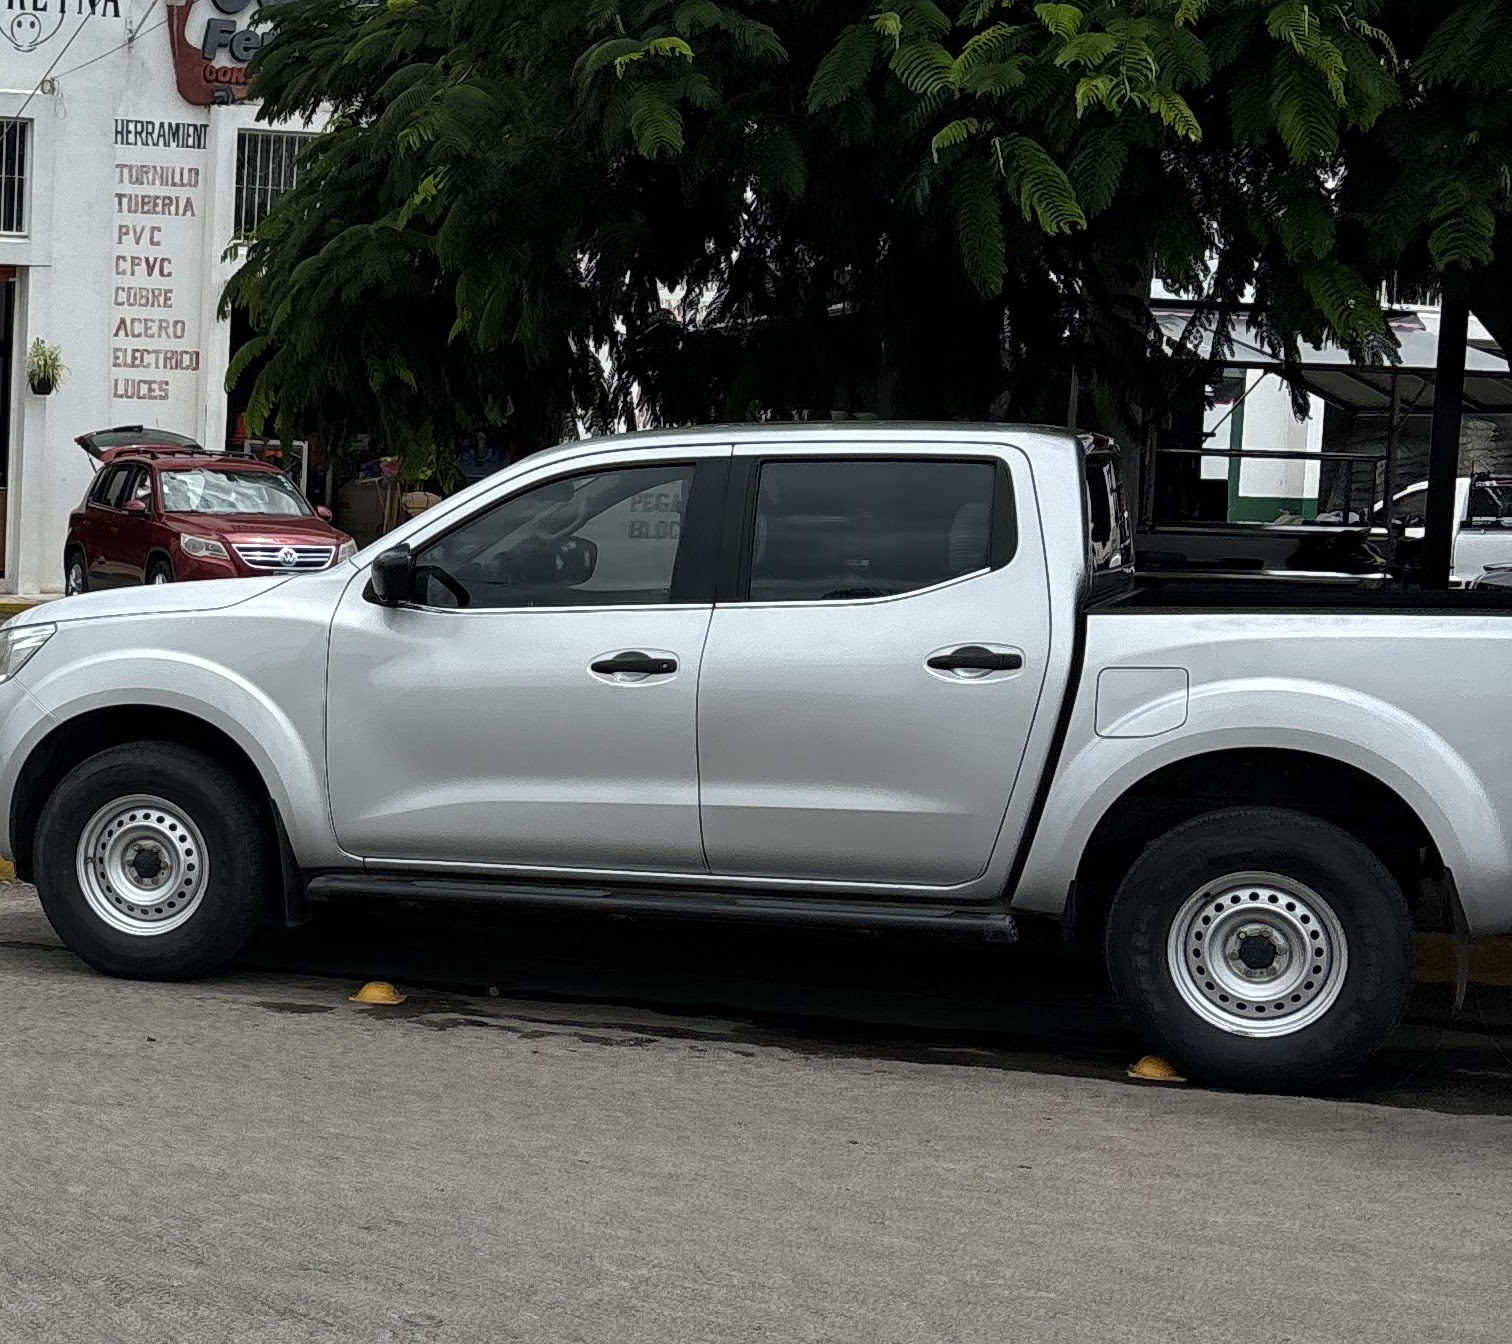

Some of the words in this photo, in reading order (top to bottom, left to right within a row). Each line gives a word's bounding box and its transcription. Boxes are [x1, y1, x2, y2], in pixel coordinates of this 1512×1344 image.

[115, 193, 197, 217] TUBERIA
[114, 286, 174, 309] COBRE
[113, 317, 186, 339] ACERO
[112, 347, 200, 371] ELECTRICO
[113, 378, 170, 400] LUCES
